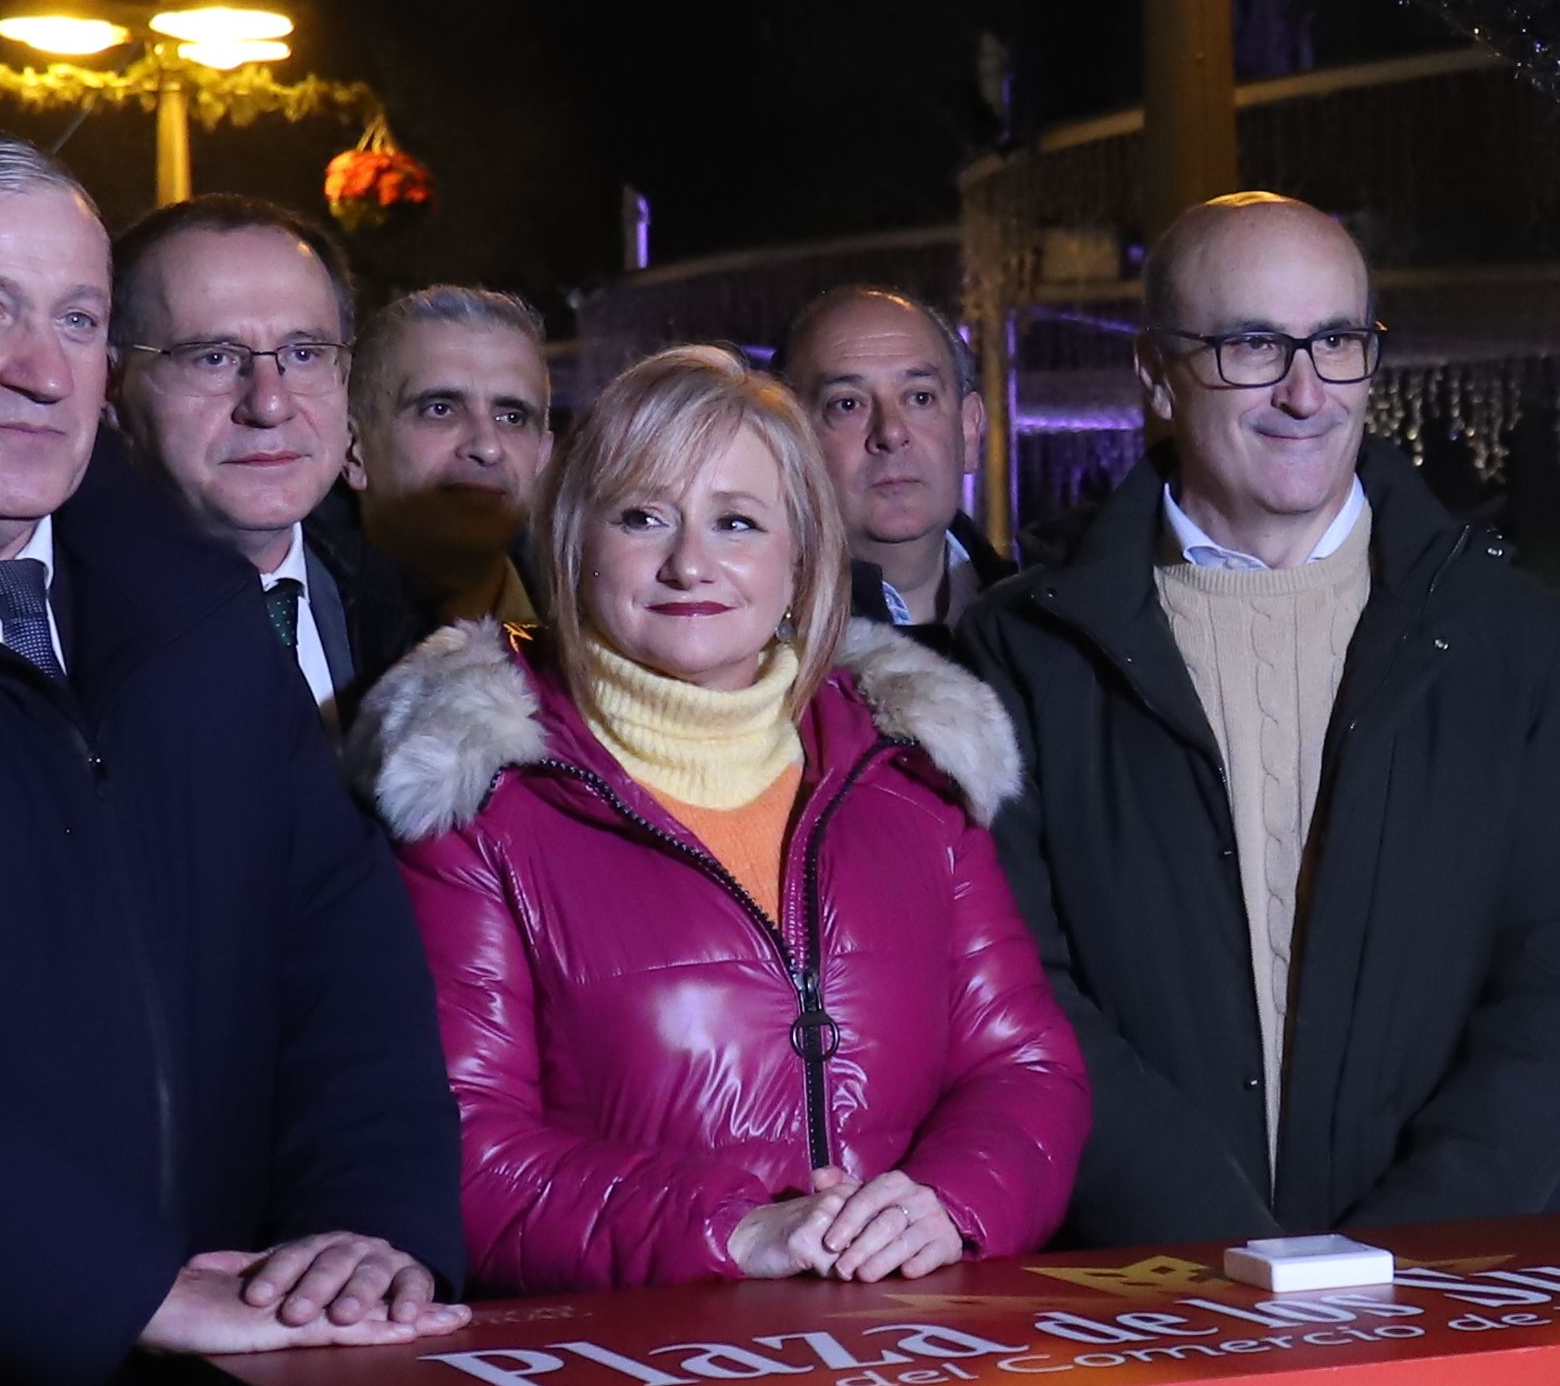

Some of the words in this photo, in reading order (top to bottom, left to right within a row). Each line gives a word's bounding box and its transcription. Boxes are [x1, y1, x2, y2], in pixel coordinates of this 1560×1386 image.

[996, 1324, 1425, 1373] Comercio
[1448, 1312, 1552, 1332] de
[1034, 1309, 1218, 1348] de
[1175, 1294, 1424, 1328] los
